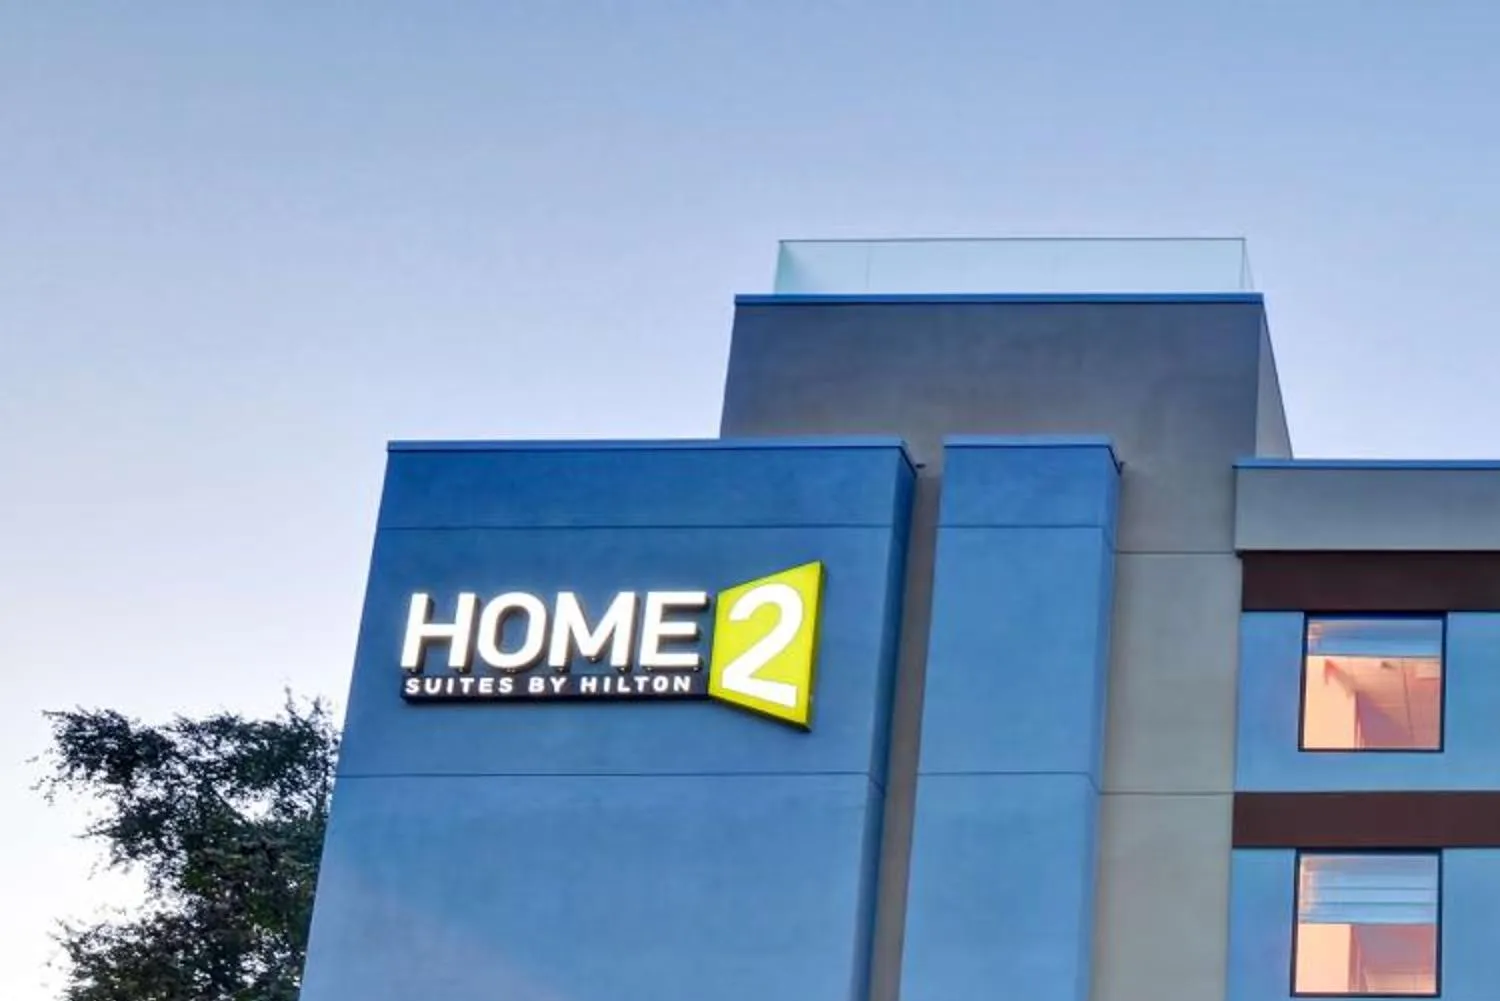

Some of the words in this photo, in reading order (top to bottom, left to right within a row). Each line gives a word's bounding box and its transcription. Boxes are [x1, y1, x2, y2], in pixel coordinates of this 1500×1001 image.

[401, 591, 707, 669] HOME
[721, 583, 804, 709] 2
[405, 677, 514, 695] SUITES
[529, 677, 567, 694] BY
[580, 675, 692, 693] HILTON
